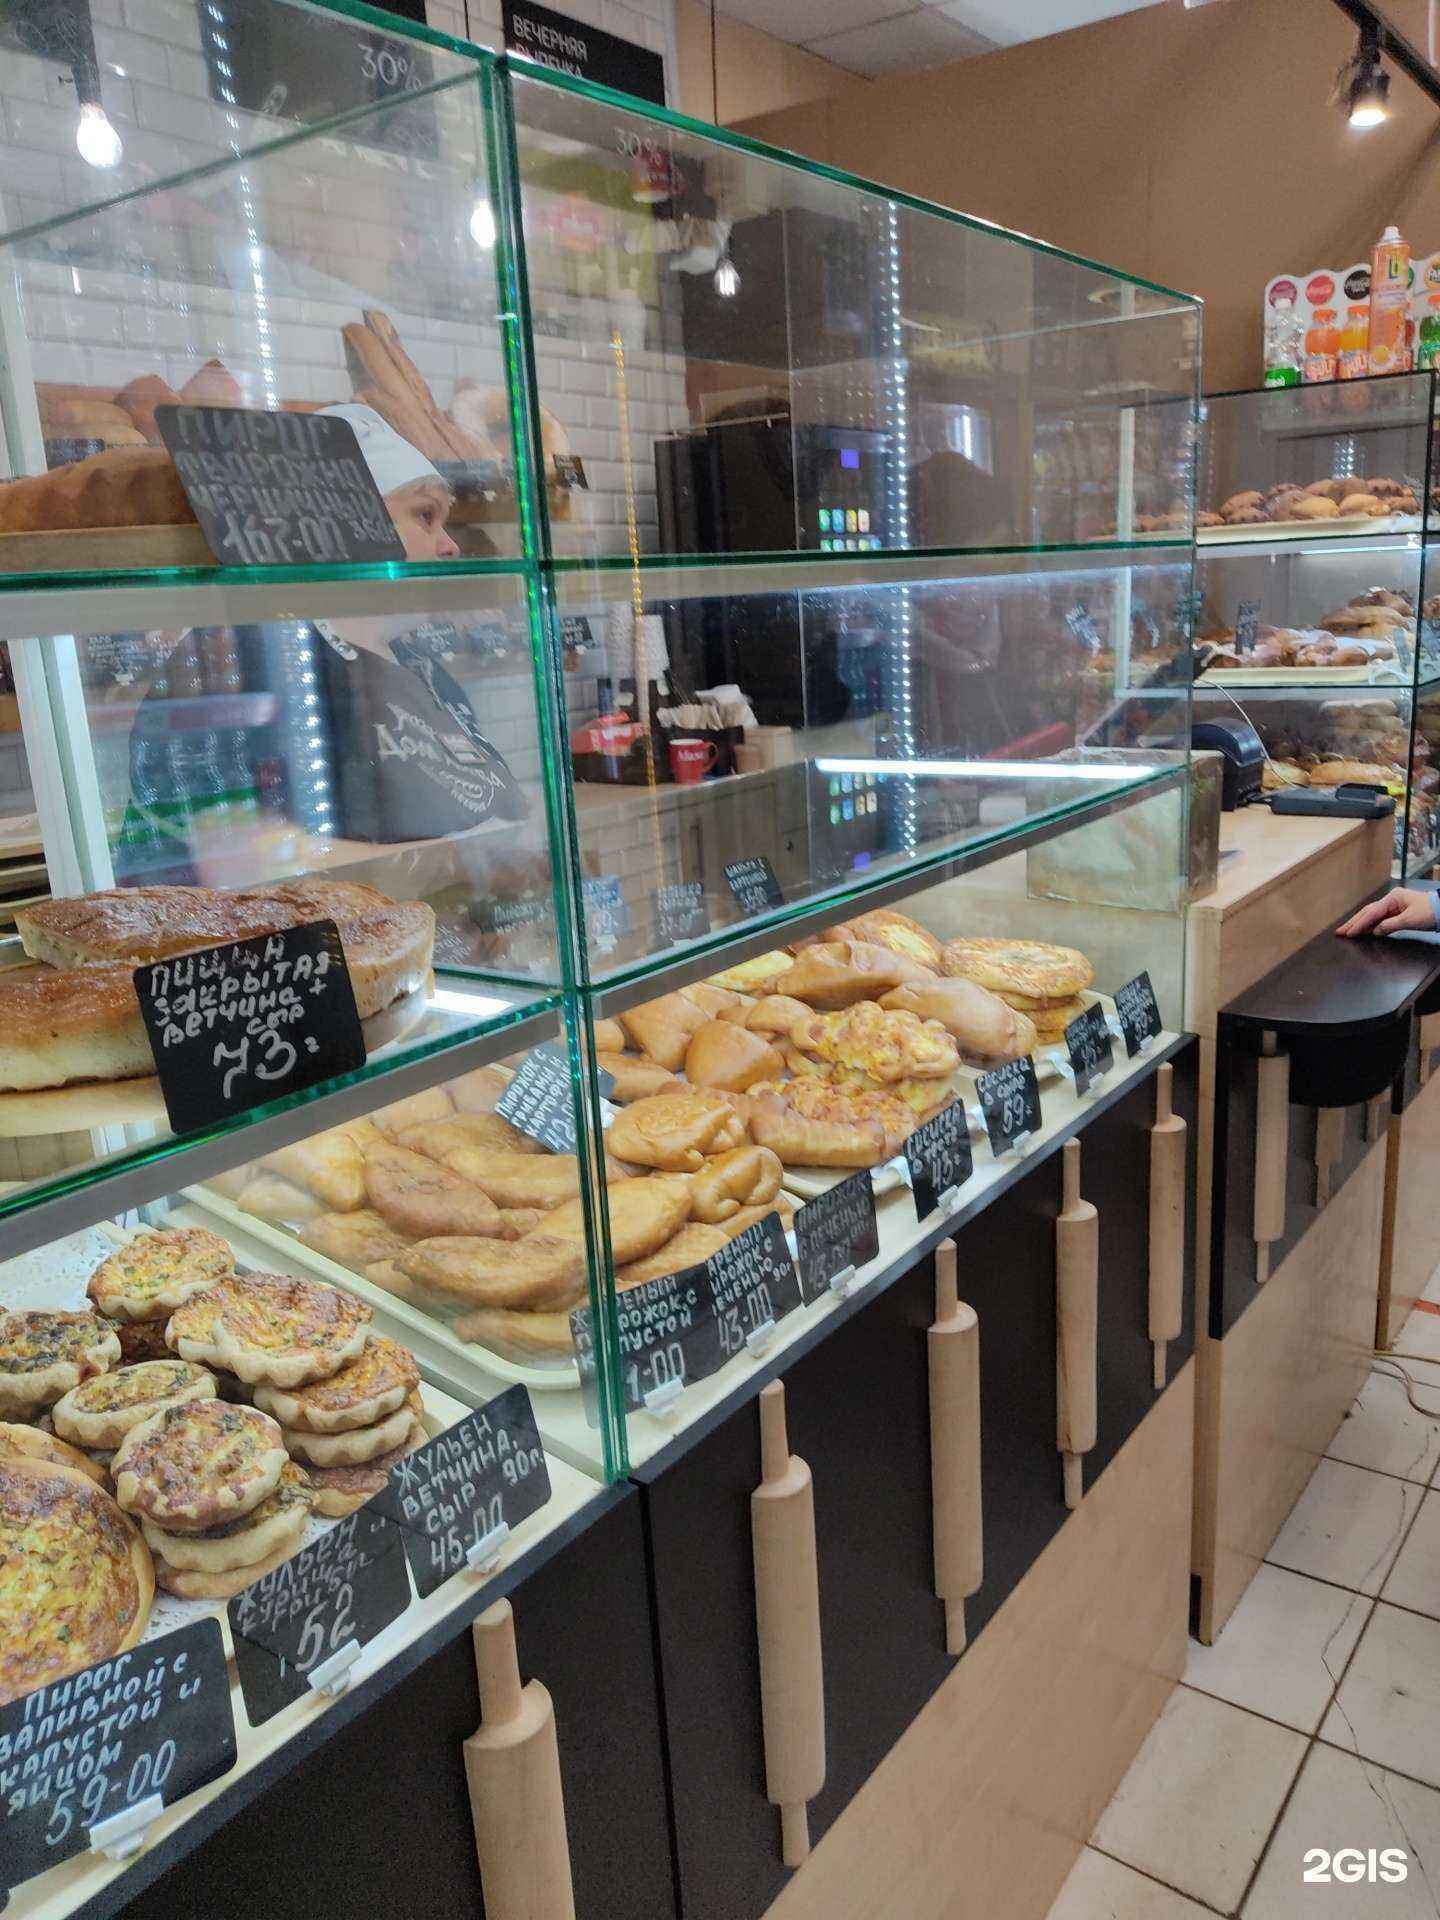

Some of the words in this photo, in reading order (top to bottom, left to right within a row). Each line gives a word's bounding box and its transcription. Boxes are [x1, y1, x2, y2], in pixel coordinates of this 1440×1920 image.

[513, 14, 588, 62] ВЕЧЕРНЯЯ
[708, 1221, 766, 1279] АРЕНЫЙ
[709, 1244, 764, 1297] ИРОЖОК
[392, 1413, 493, 1498] ЖУЛЬЕН
[426, 1481, 477, 1534] СЫР
[23, 1653, 132, 1723] ПИРОГ
[0, 1690, 162, 1796] КАПУСТОЙ
[45, 1739, 177, 1846] 59-00
